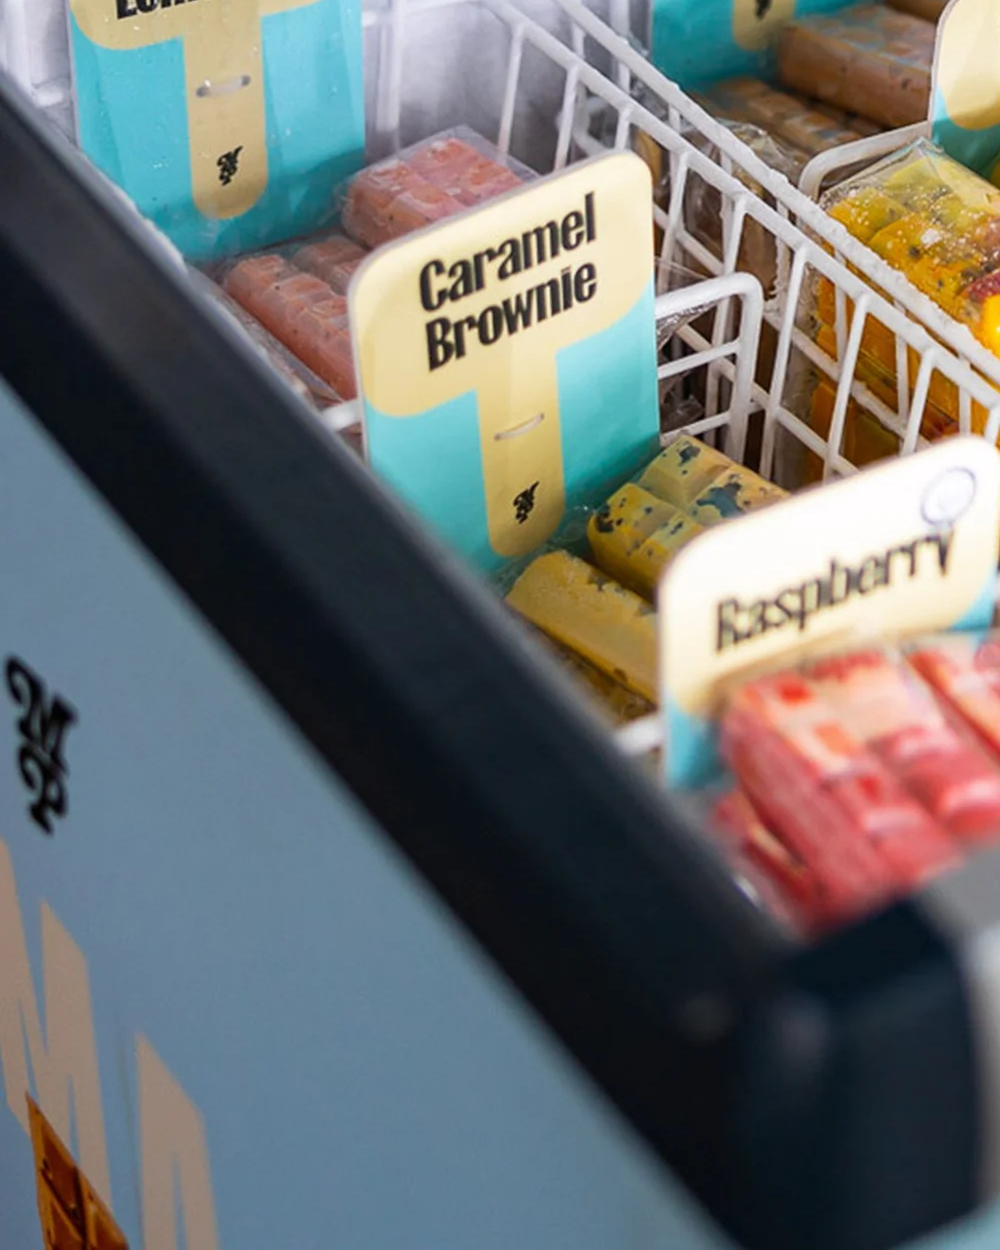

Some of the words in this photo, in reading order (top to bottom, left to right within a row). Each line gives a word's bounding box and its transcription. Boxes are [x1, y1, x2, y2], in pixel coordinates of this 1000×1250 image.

[418, 190, 597, 313] Caramel
[425, 262, 597, 373] Brownie
[715, 531, 953, 652] Raspberry
